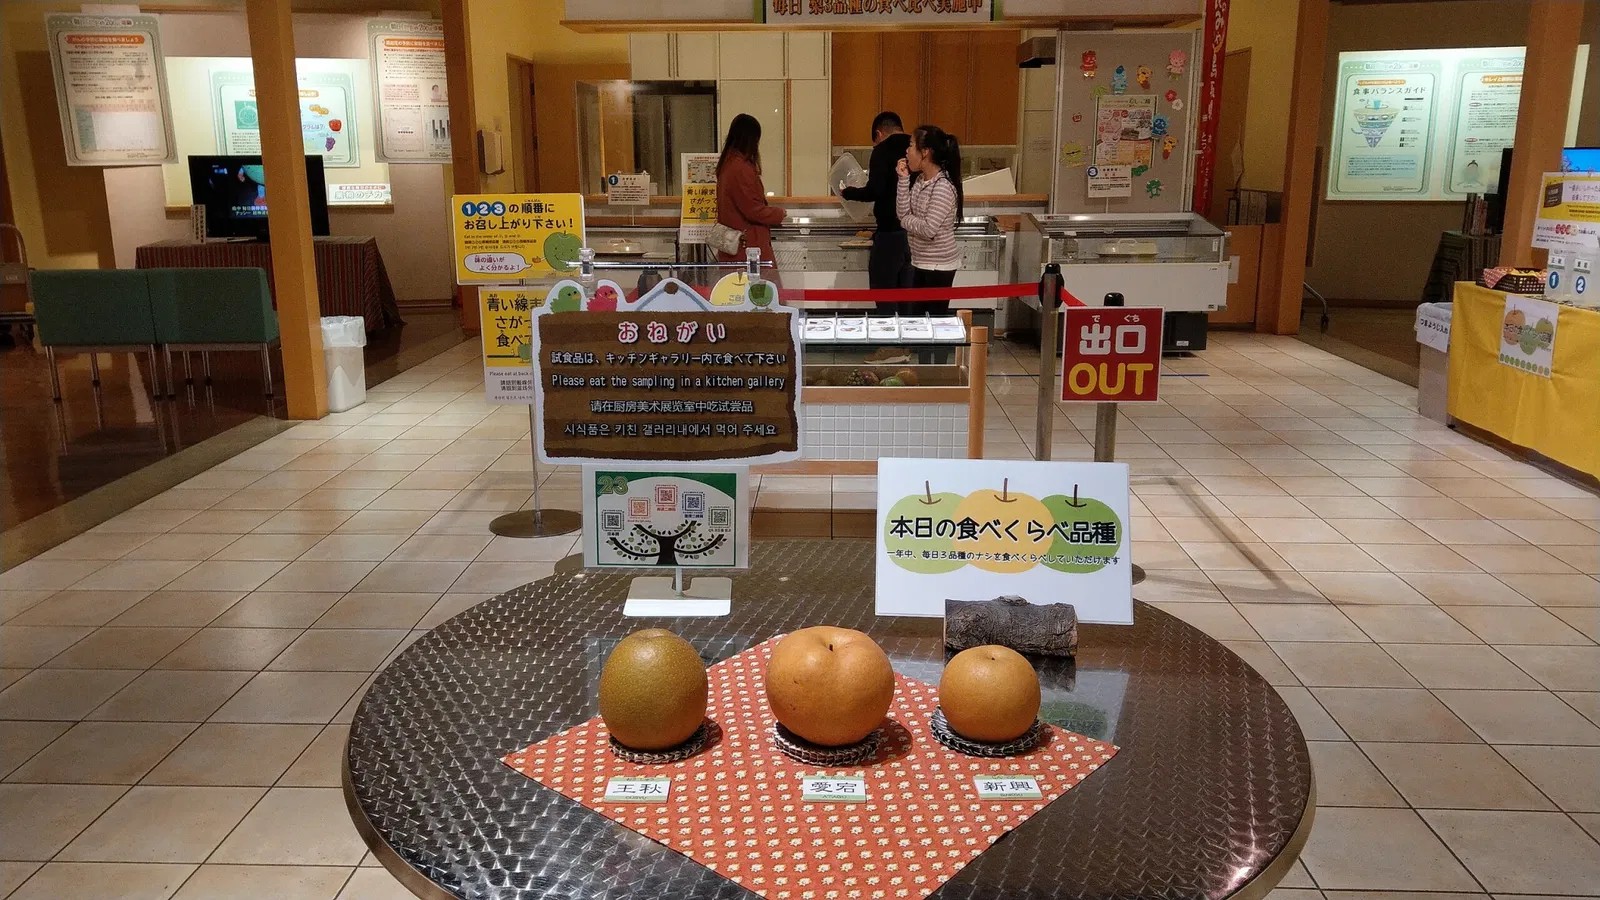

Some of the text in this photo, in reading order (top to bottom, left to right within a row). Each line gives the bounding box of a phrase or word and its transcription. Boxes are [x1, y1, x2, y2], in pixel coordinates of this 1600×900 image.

[1353, 87, 1426, 95] 食事バランスガイド
[464, 218, 573, 230] お召し上がり下さい！
[618, 321, 726, 343] おねがい
[1420, 319, 1448, 334] つまようじ入れ
[1079, 323, 1146, 355] 出口
[551, 351, 786, 365] 試食品は、キッチンギャラリー内で食べて下さい
[552, 375, 785, 390] Please eat the sampling in a kitchen gallery
[1068, 362, 1154, 395] OUT
[590, 400, 753, 413] 请在厨房美术展览室中吃试尝品
[564, 423, 776, 436] 시식품은 키친 갤러리내에서 먹어 주세요
[598, 476, 629, 495] 23
[890, 516, 1117, 544] 本日の食べくらべ品種
[613, 784, 662, 794] 王秋
[810, 782, 856, 793] 愛宕
[984, 781, 1033, 791] 新興
